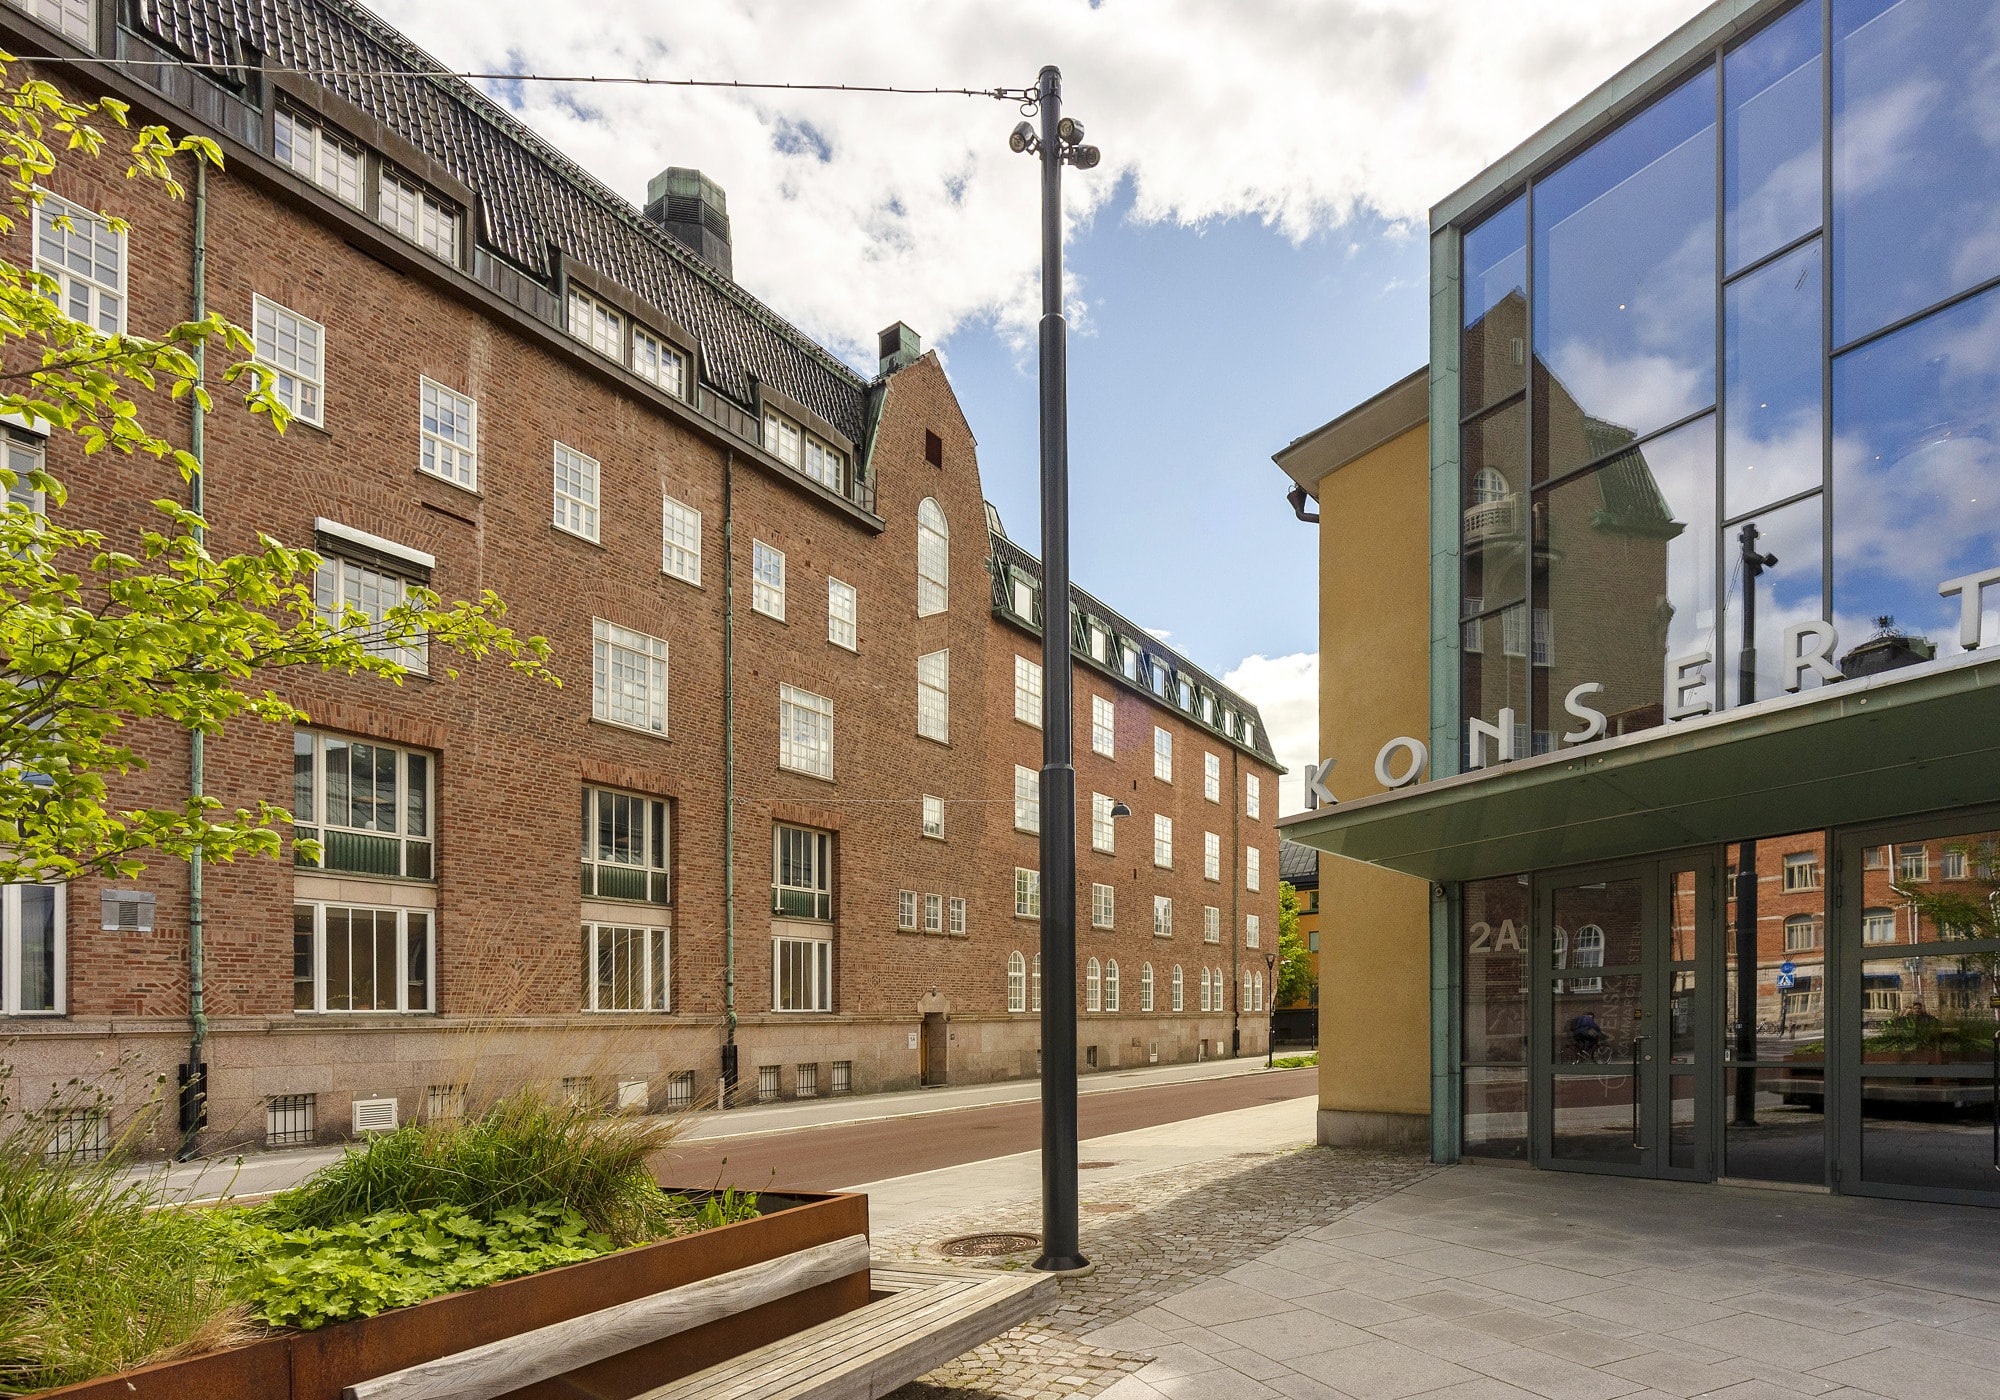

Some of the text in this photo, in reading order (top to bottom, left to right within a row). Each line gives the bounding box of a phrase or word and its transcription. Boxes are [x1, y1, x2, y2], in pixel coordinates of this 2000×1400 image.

[1304, 566, 2000, 810] KONSERT
[1468, 918, 1521, 954] 2A
[1597, 975, 1622, 1056] SVENSK
